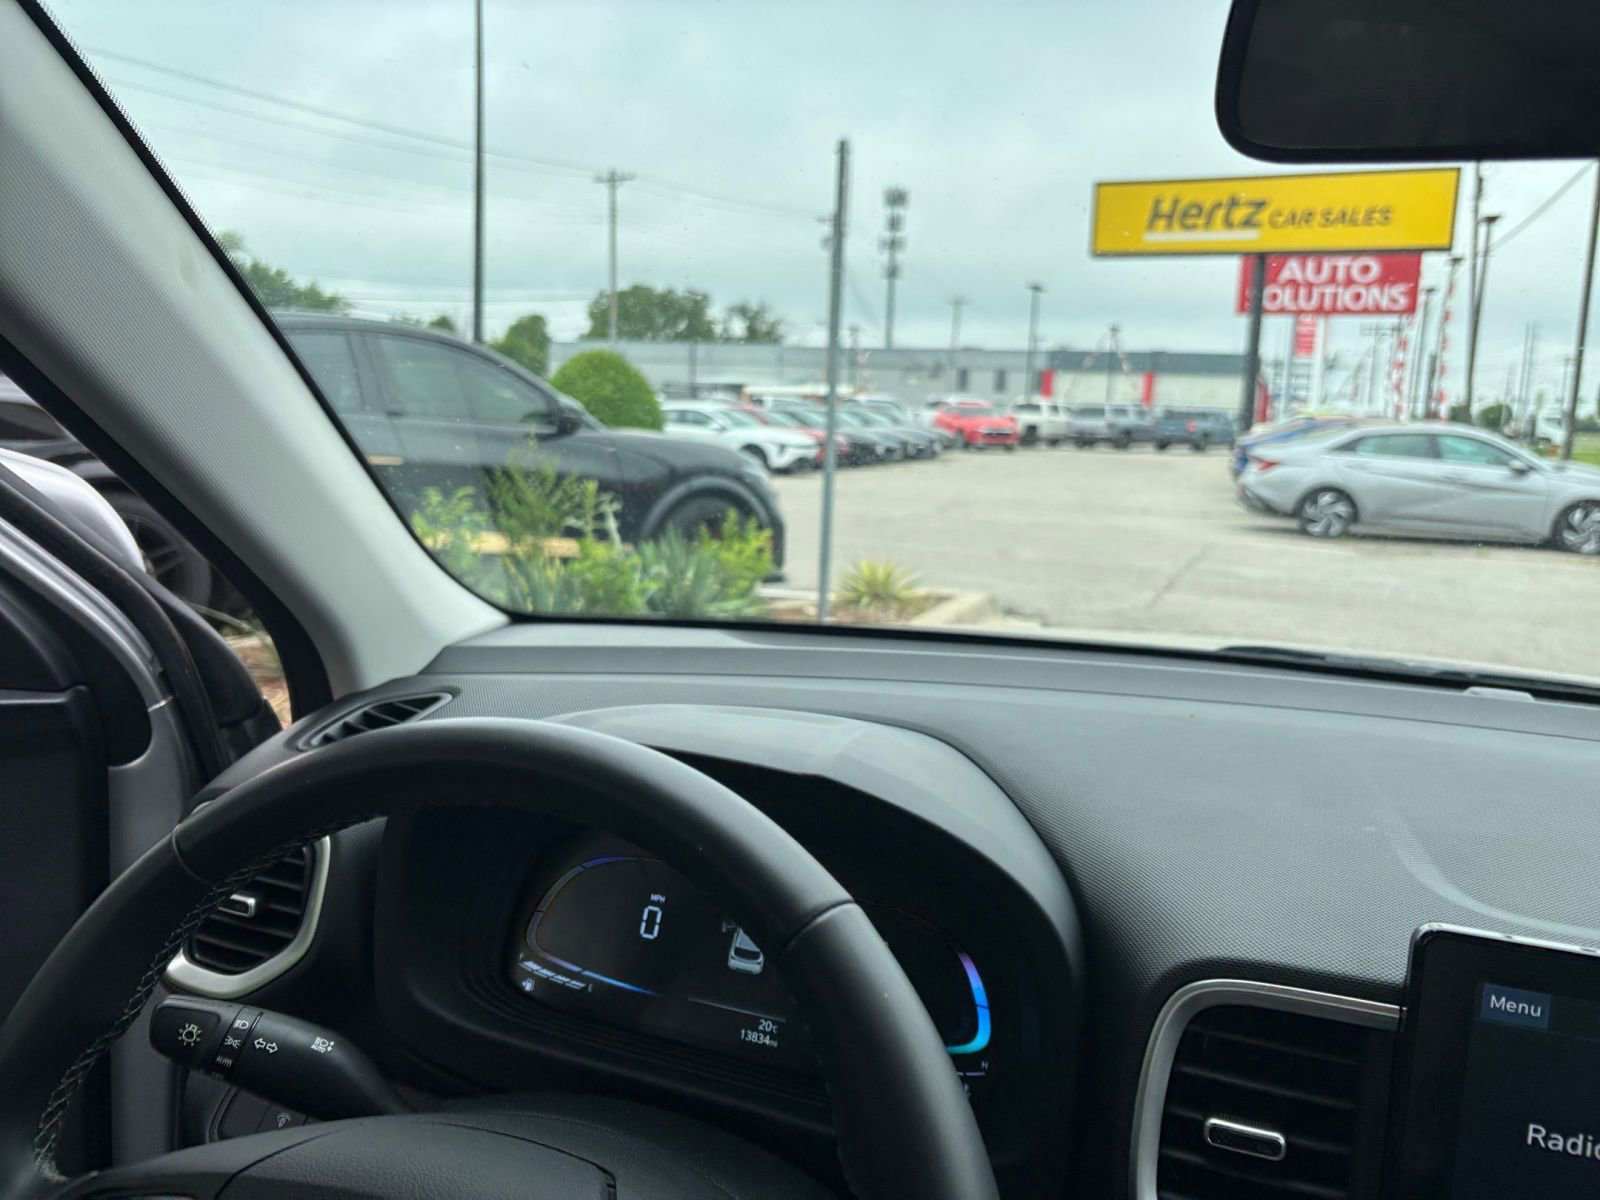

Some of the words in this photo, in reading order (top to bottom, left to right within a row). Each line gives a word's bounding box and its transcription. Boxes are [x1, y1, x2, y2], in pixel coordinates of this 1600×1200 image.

[1146, 194, 1269, 232] Hertz
[1268, 208, 1315, 229] CAR
[1318, 204, 1393, 227] SALES
[1278, 256, 1381, 284] AUTO
[1245, 283, 1411, 312] OLUTIONS
[650, 894, 665, 903] MPH
[640, 905, 662, 939] 0
[1490, 994, 1542, 1018] Menu
[311, 1044, 326, 1053] AUTO
